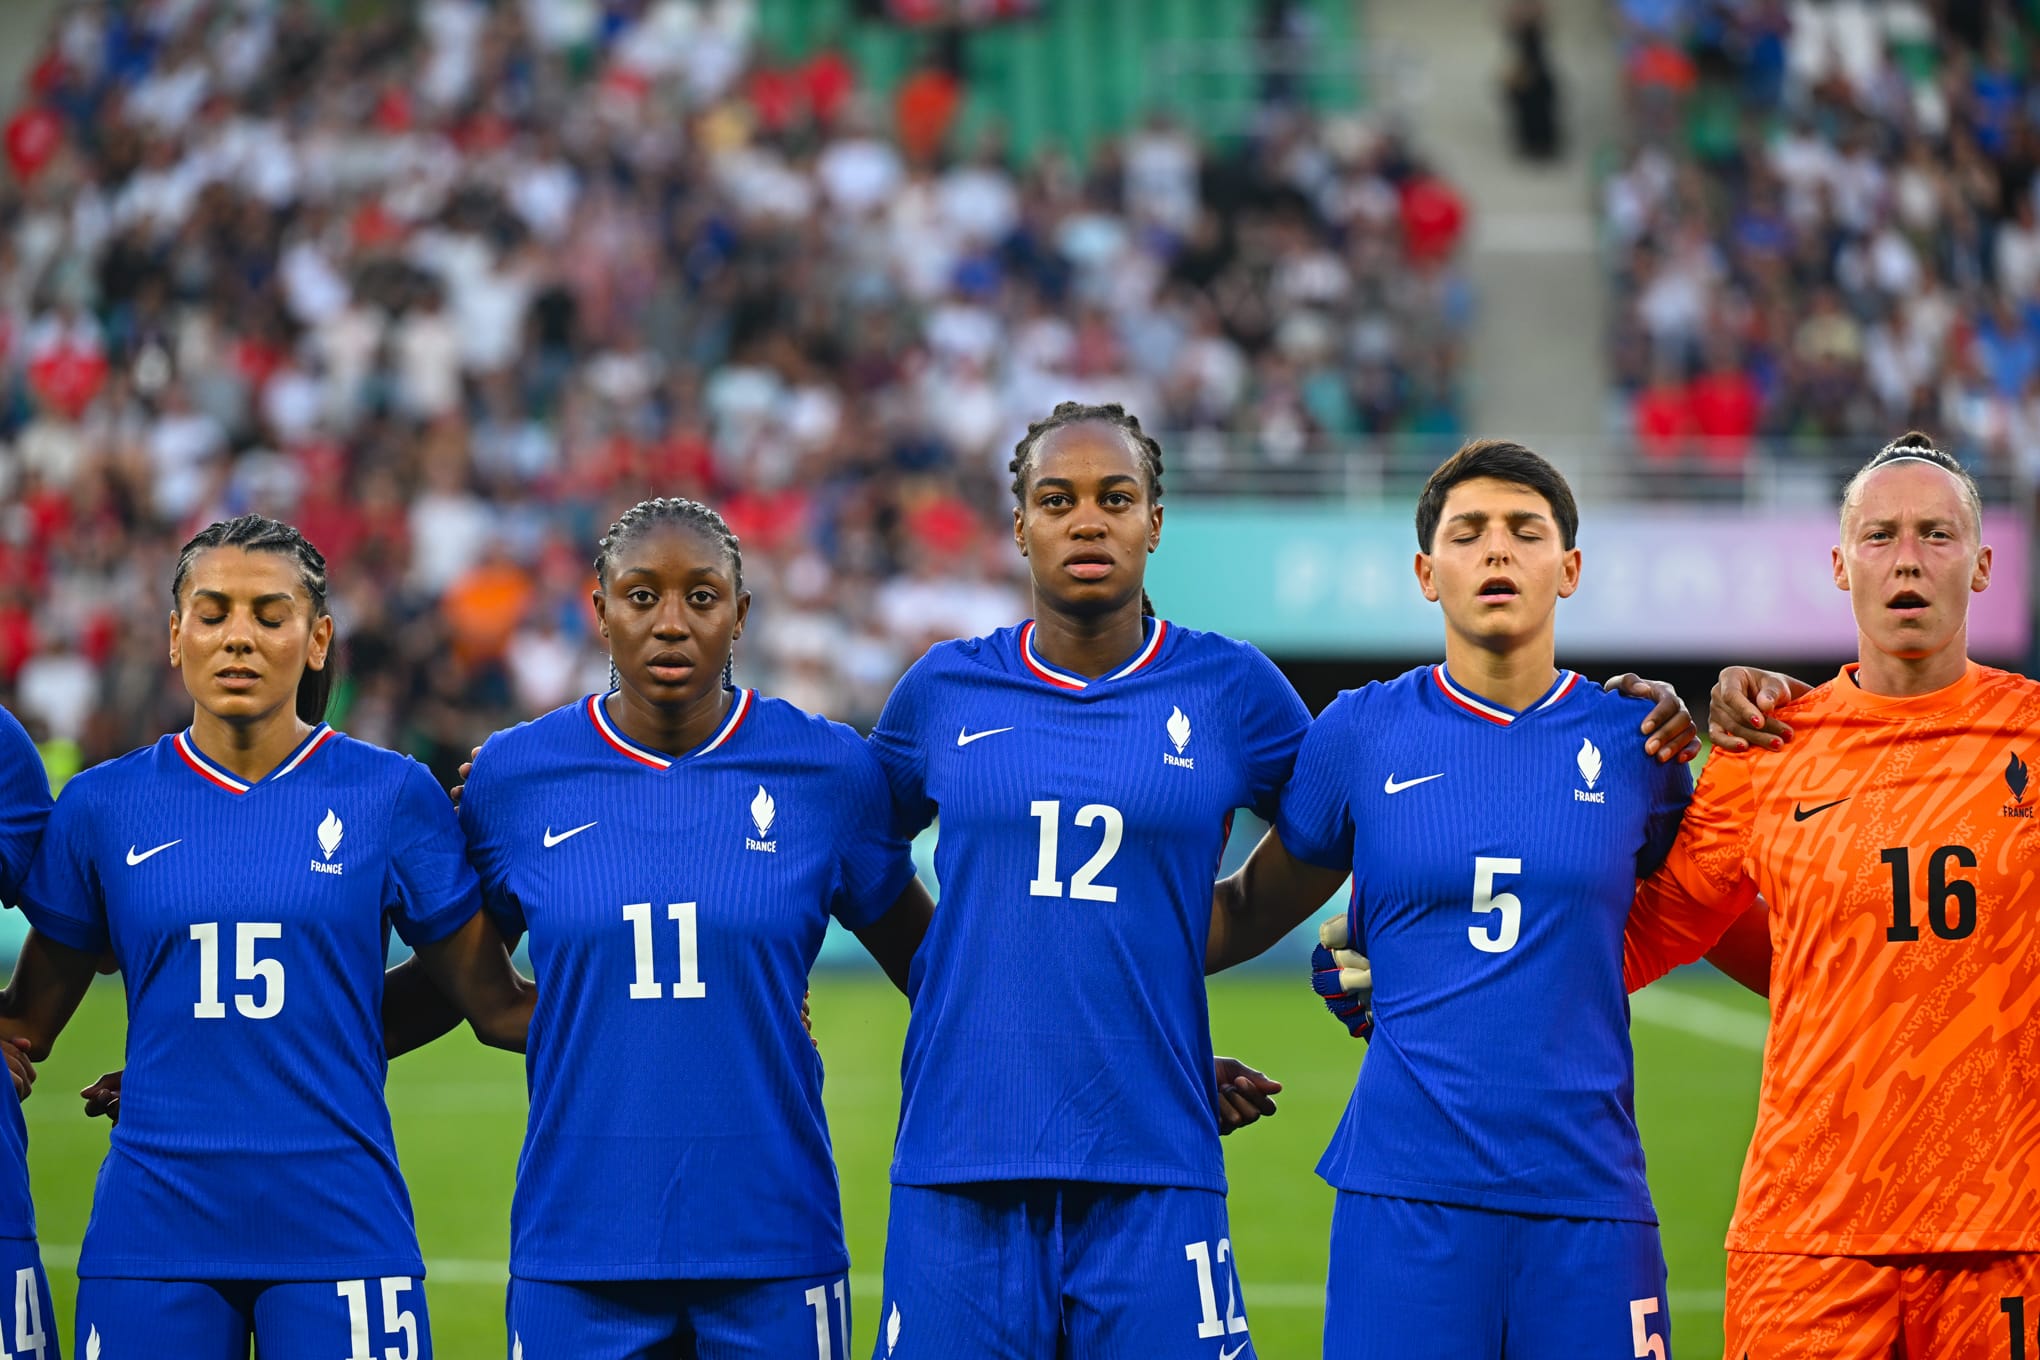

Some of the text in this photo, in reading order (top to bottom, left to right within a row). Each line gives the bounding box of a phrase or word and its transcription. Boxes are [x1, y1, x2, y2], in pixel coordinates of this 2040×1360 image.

[1163, 752, 1194, 769] FRANCE
[1574, 788, 1605, 803] FRANCE
[745, 837, 777, 853] FRANCE
[1029, 800, 1123, 902] 12
[2003, 804, 2034, 818] FRANCE
[310, 859, 343, 875] FRANCE
[1468, 857, 1521, 953] 5
[1881, 845, 1977, 942] 16
[189, 922, 285, 1019] 15
[623, 901, 706, 999] 11
[0, 1268, 46, 1360] 4
[337, 1276, 418, 1360] 15
[804, 1284, 850, 1360] 11
[1185, 1239, 1247, 1340] 12
